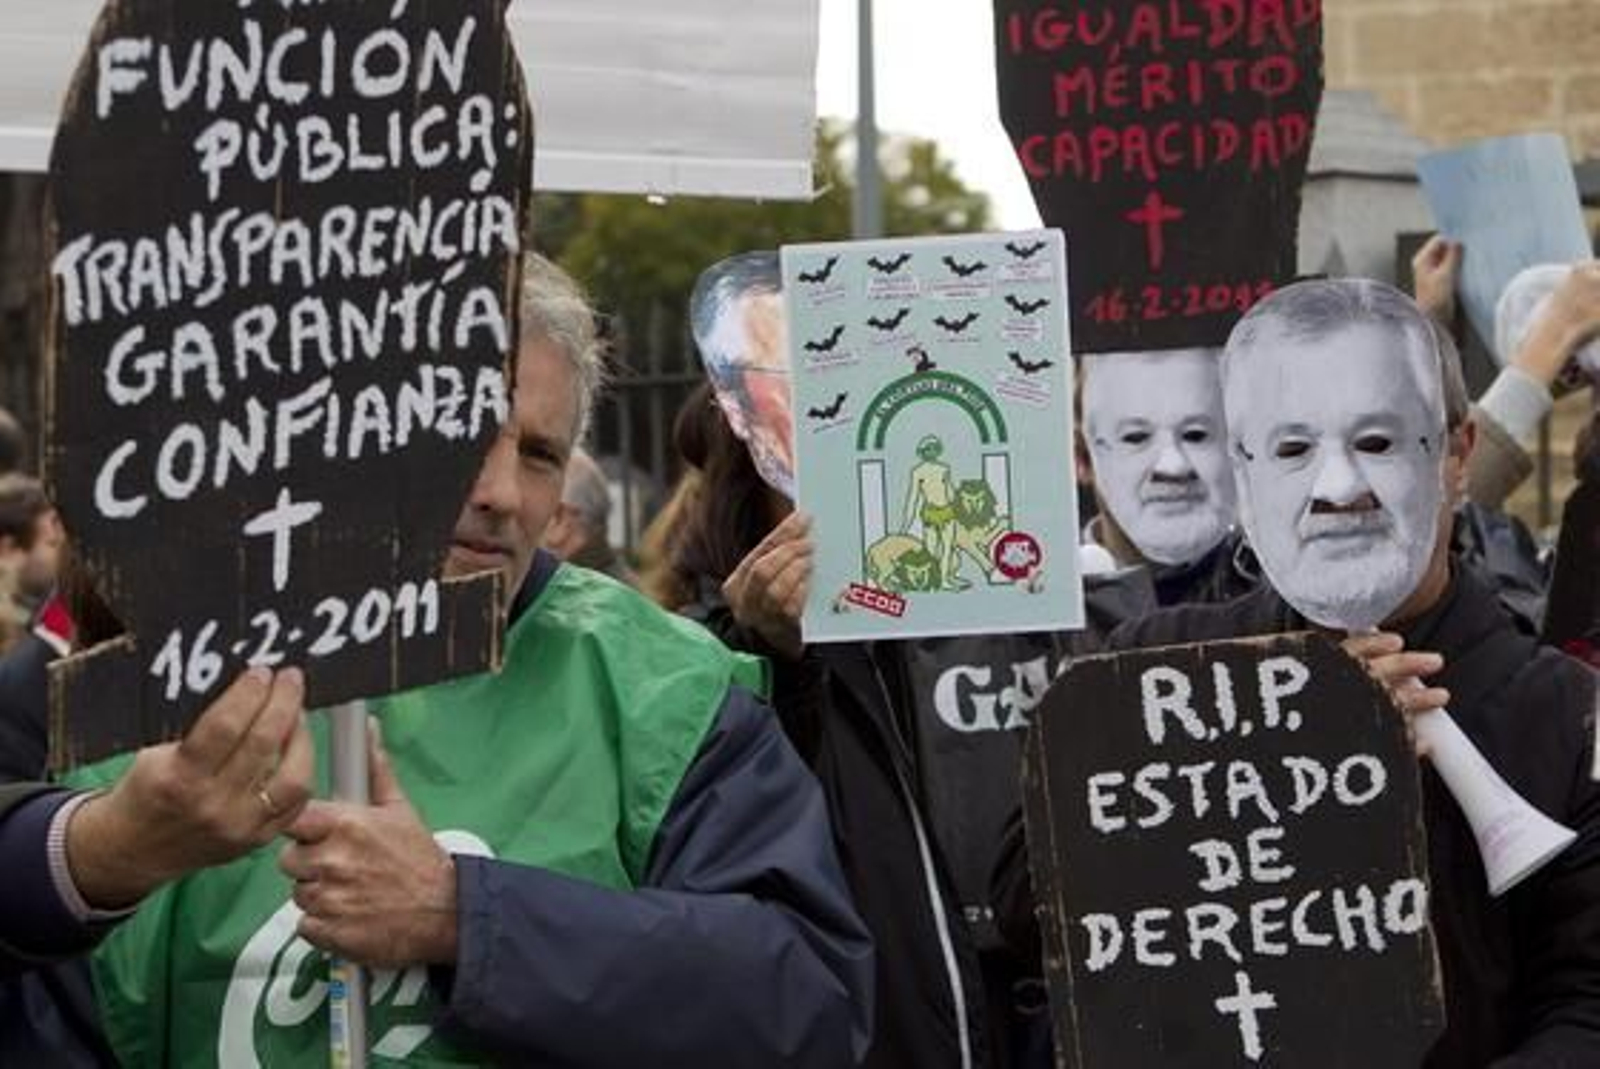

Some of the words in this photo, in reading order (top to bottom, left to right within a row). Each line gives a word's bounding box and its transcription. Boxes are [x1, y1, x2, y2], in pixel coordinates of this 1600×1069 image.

[97, 0, 475, 117] FUNCIÓN
[1056, 44, 1299, 118] MÉRITO
[195, 95, 517, 200] PÚBLICA:
[1018, 112, 1309, 182] CAPACIDAD
[105, 262, 508, 400] GARANTÍA
[94, 364, 510, 518] CONFIANZA
[1086, 754, 1387, 833] ESTADO
[1189, 827, 1295, 891] DE
[1081, 878, 1429, 972] DERECHO
